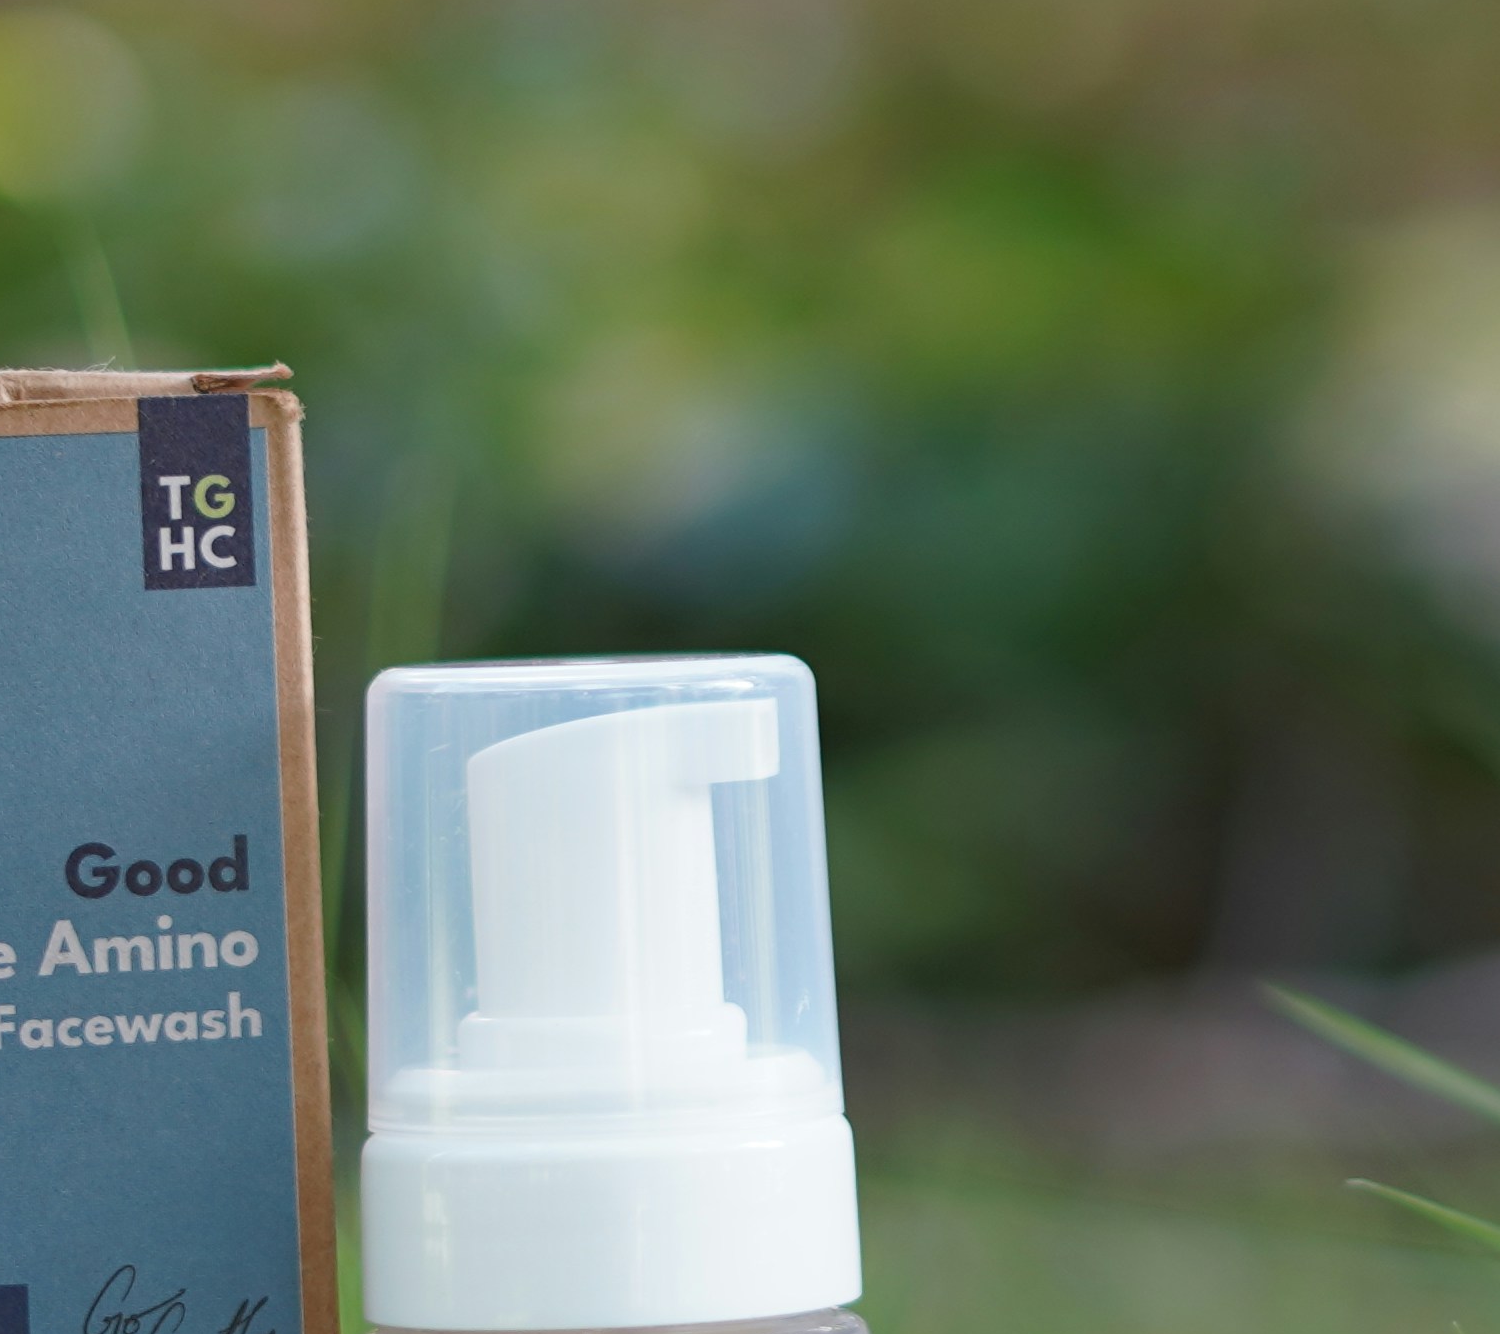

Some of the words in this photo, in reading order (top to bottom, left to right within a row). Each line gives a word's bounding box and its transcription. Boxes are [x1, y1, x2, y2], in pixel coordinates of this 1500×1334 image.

[158, 474, 236, 521] TG
[158, 524, 239, 571] HC
[64, 833, 250, 899] Good
[38, 914, 259, 978] Amino
